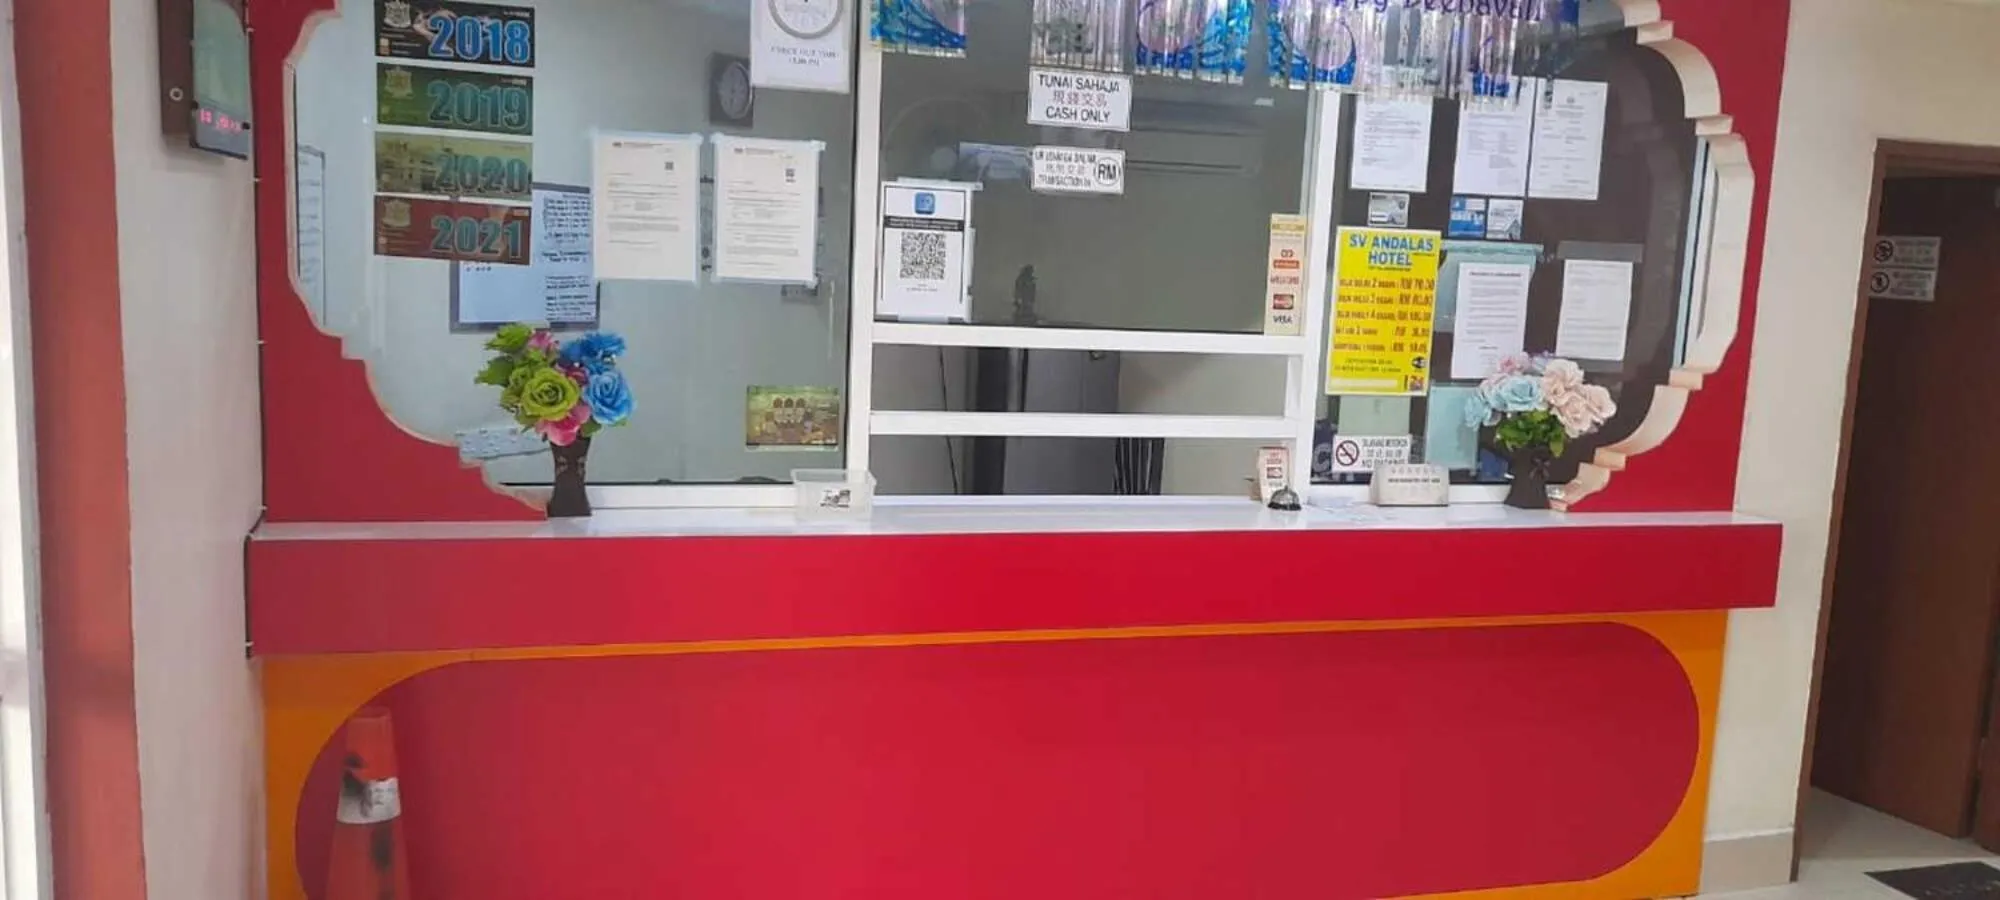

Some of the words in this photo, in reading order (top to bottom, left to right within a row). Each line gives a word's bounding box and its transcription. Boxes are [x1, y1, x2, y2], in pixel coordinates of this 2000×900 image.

[427, 15, 531, 64] 2018
[1038, 74, 1073, 89] TUNAI
[1075, 77, 1120, 94] SAHAJA
[427, 80, 529, 130] 2019
[1046, 106, 1078, 120] CASH
[1080, 108, 1111, 124] ONLY
[435, 154, 528, 194] 2020
[1098, 162, 1117, 181] RM
[430, 215, 523, 259] 2021
[1350, 234, 1367, 247] SV
[1371, 236, 1433, 252] ANDALAS
[1369, 251, 1412, 266] HOTEL
